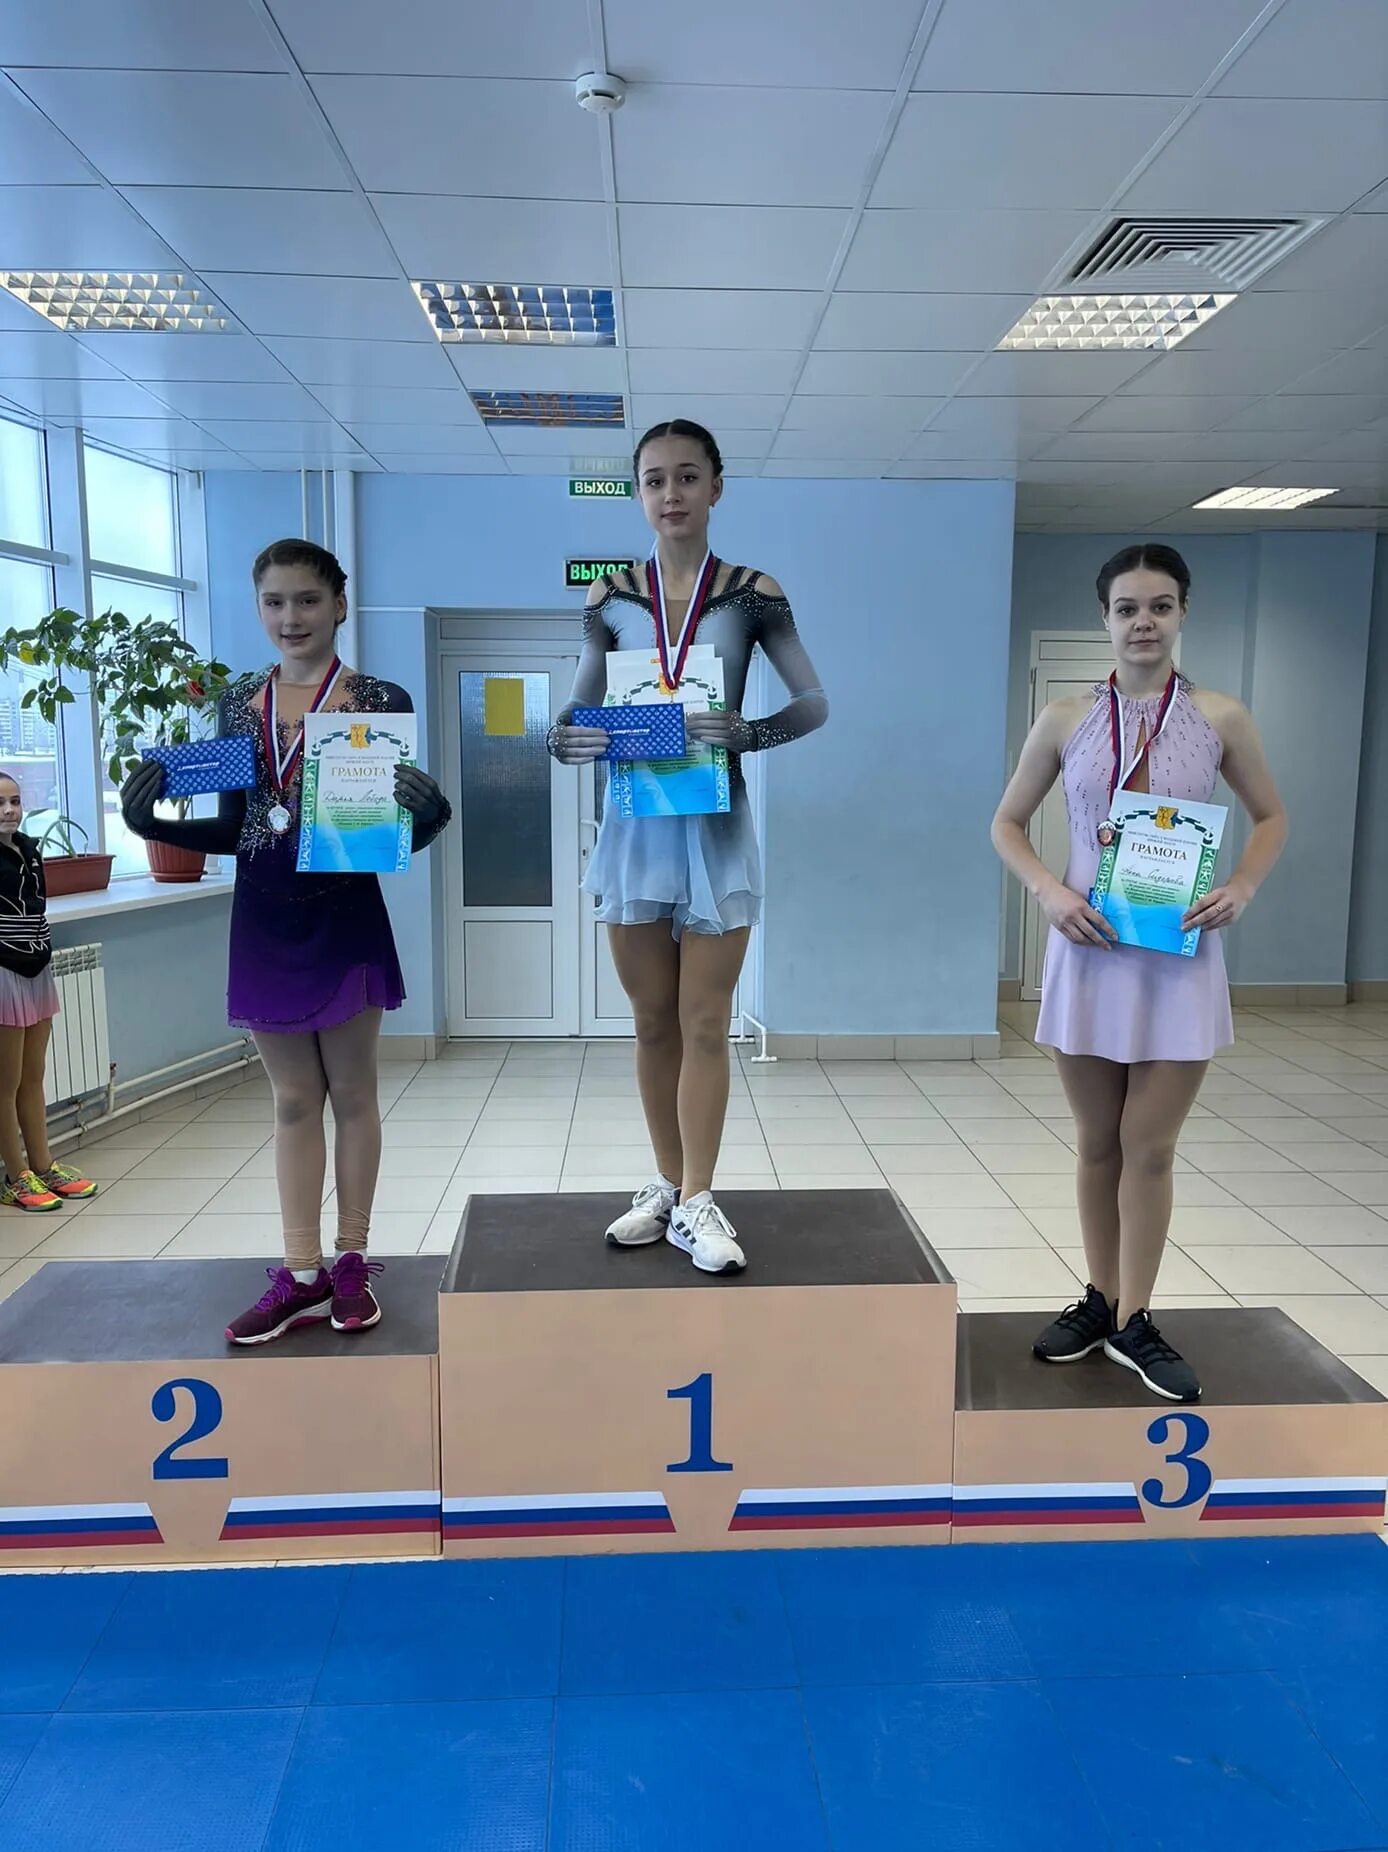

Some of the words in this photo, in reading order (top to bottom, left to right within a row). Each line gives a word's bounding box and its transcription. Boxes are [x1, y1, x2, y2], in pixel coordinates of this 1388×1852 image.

[574, 481, 626, 495] ВЫХОД
[330, 766, 388, 777] ГРАМОТА
[1130, 841, 1188, 861] ГРАМОТА
[151, 1377, 229, 1481] 2
[666, 1372, 734, 1473] 1
[1142, 1412, 1212, 1509] 3
